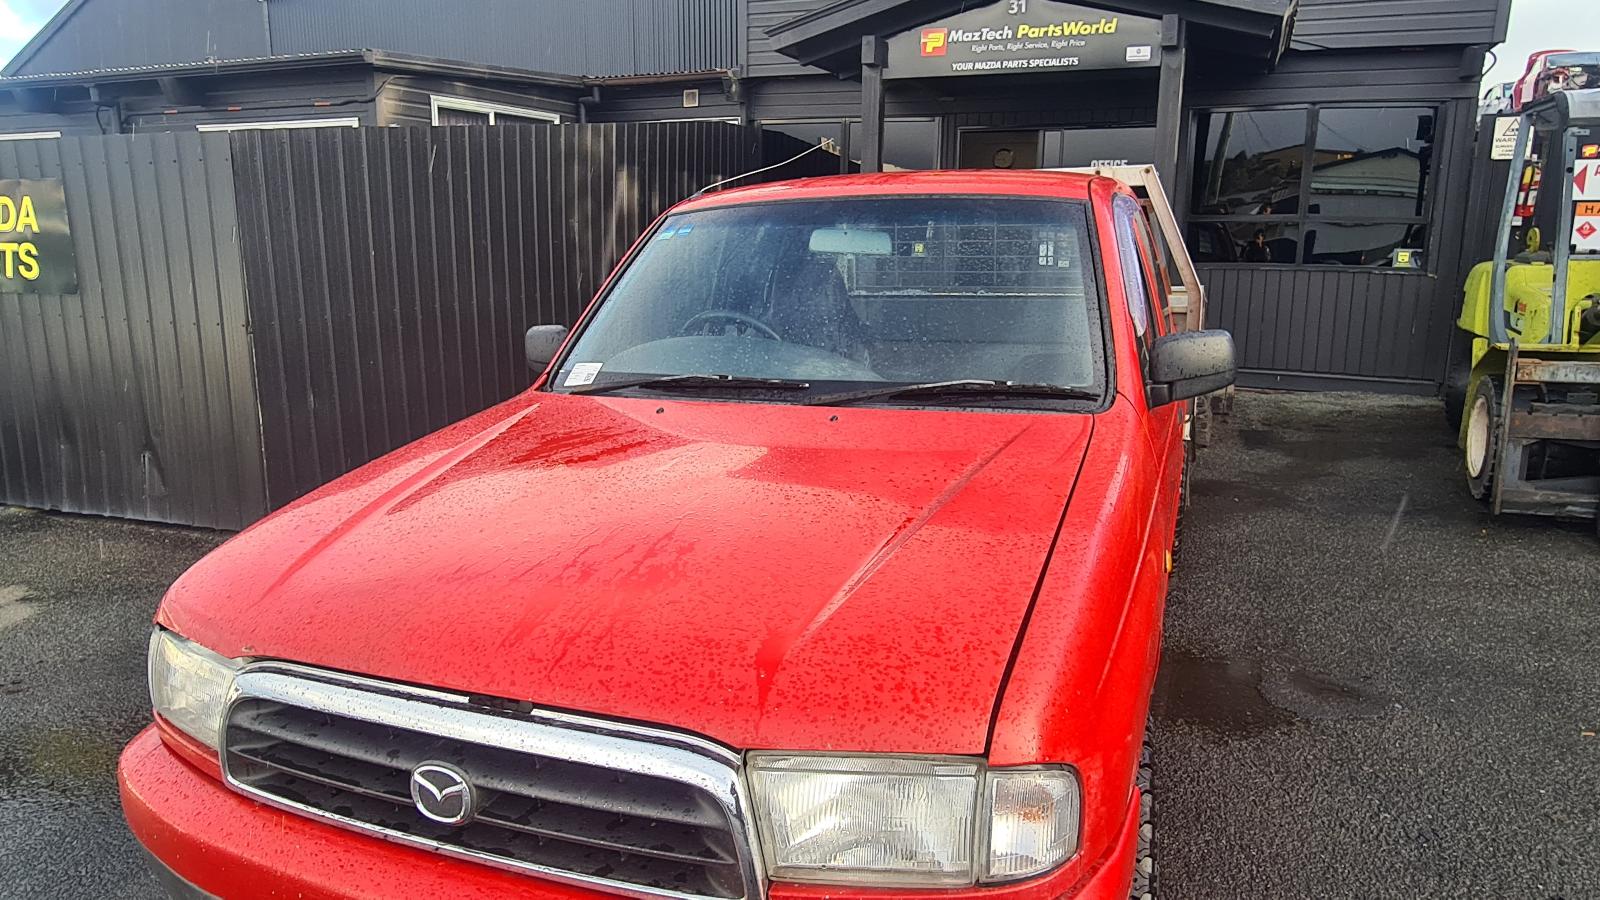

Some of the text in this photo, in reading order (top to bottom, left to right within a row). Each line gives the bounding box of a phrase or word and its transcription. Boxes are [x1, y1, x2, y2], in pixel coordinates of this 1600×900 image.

[1008, 0, 1026, 14] 31
[948, 18, 1118, 43] MazTech PartsWorld
[971, 39, 1086, 53] Right Parts, Right Service, Right Price
[952, 57, 1079, 71] YOUR MAZDA PARTS SPECIALISTS
[0, 242, 40, 280] TS
